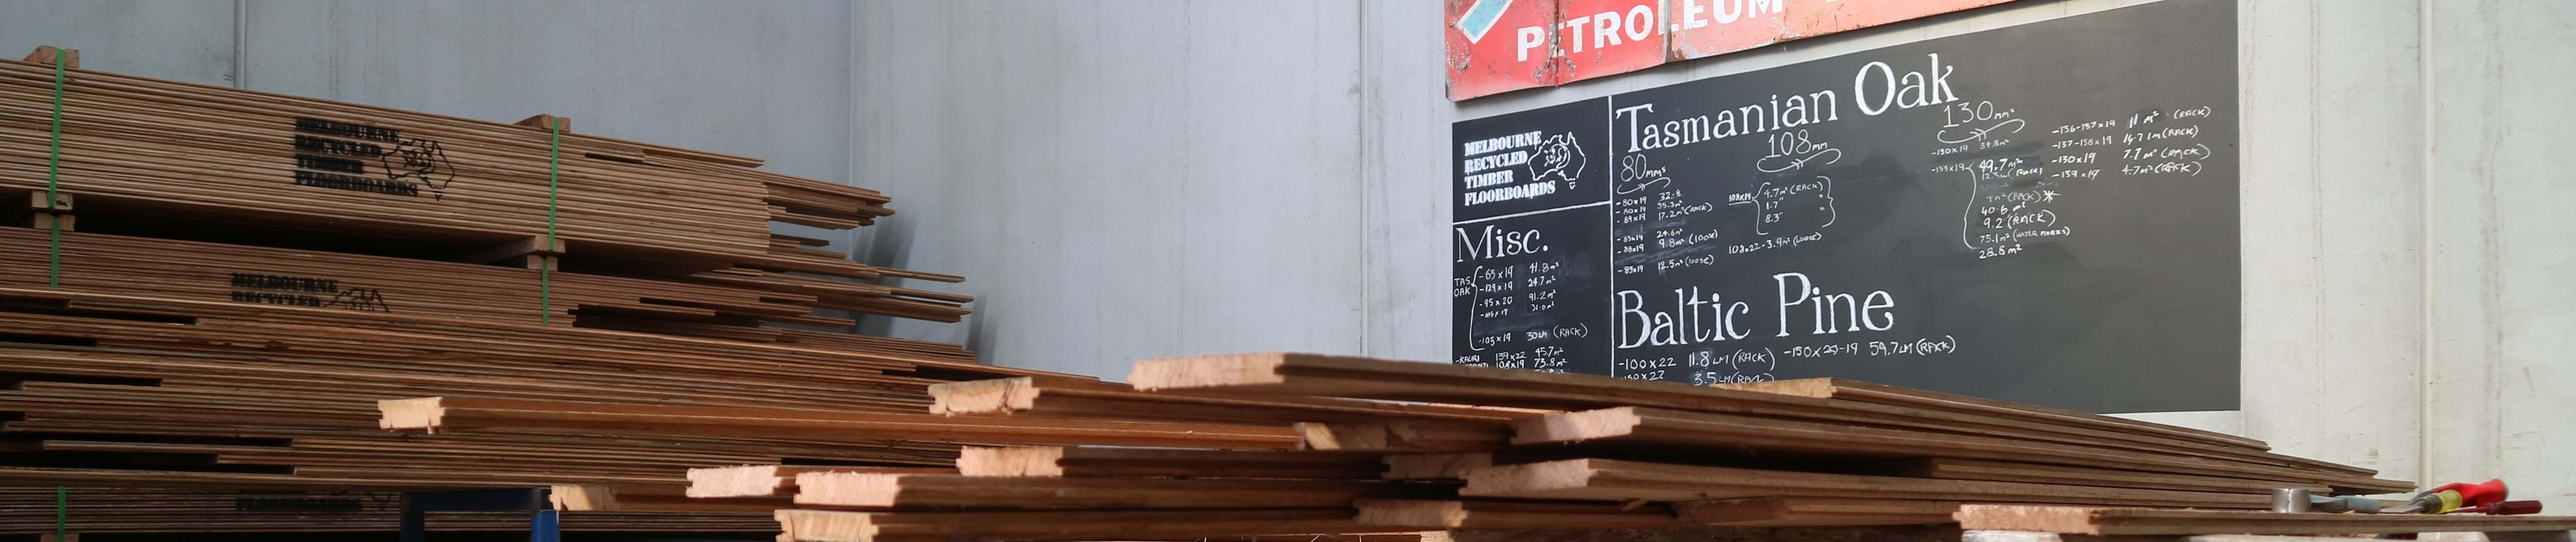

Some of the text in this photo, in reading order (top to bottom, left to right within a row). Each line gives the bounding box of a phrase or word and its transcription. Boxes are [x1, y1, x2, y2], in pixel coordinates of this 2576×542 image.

[1616, 53, 1959, 153] Tasmanian Oak
[1464, 131, 1542, 156] MELBOURNE
[1465, 150, 1528, 174] RECYCLED
[1465, 169, 1514, 189] TIMBER
[1465, 180, 1556, 206] FLOORBOARDS
[1456, 225, 1548, 262] Misc.
[1454, 276, 1471, 286] TAS
[1454, 286, 1471, 297] OAK
[1617, 272, 1895, 348] Baltic Pine
[1553, 322, 1588, 338] (RACK)
[1732, 347, 1775, 371] (RACK)
